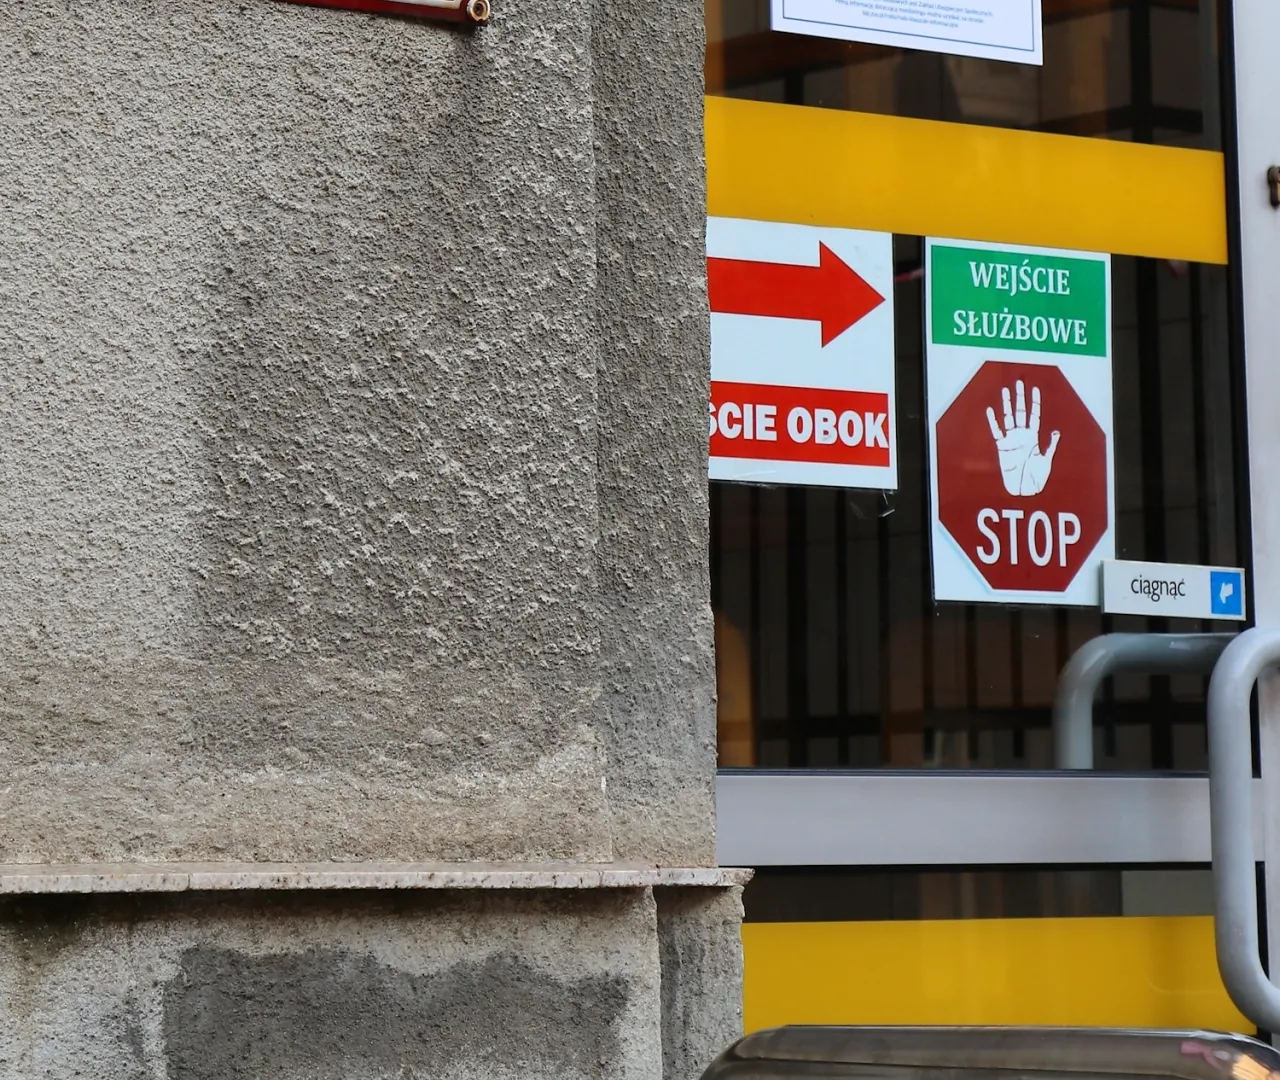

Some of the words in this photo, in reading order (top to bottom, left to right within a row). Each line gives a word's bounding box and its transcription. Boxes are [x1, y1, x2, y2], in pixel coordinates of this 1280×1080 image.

[969, 260, 1070, 296] WEJŚCIE
[953, 307, 1087, 345] SŁUŻBOWE
[786, 406, 890, 449] OBOK
[976, 507, 1082, 567] STOP
[1130, 574, 1187, 602] ciągnąć
